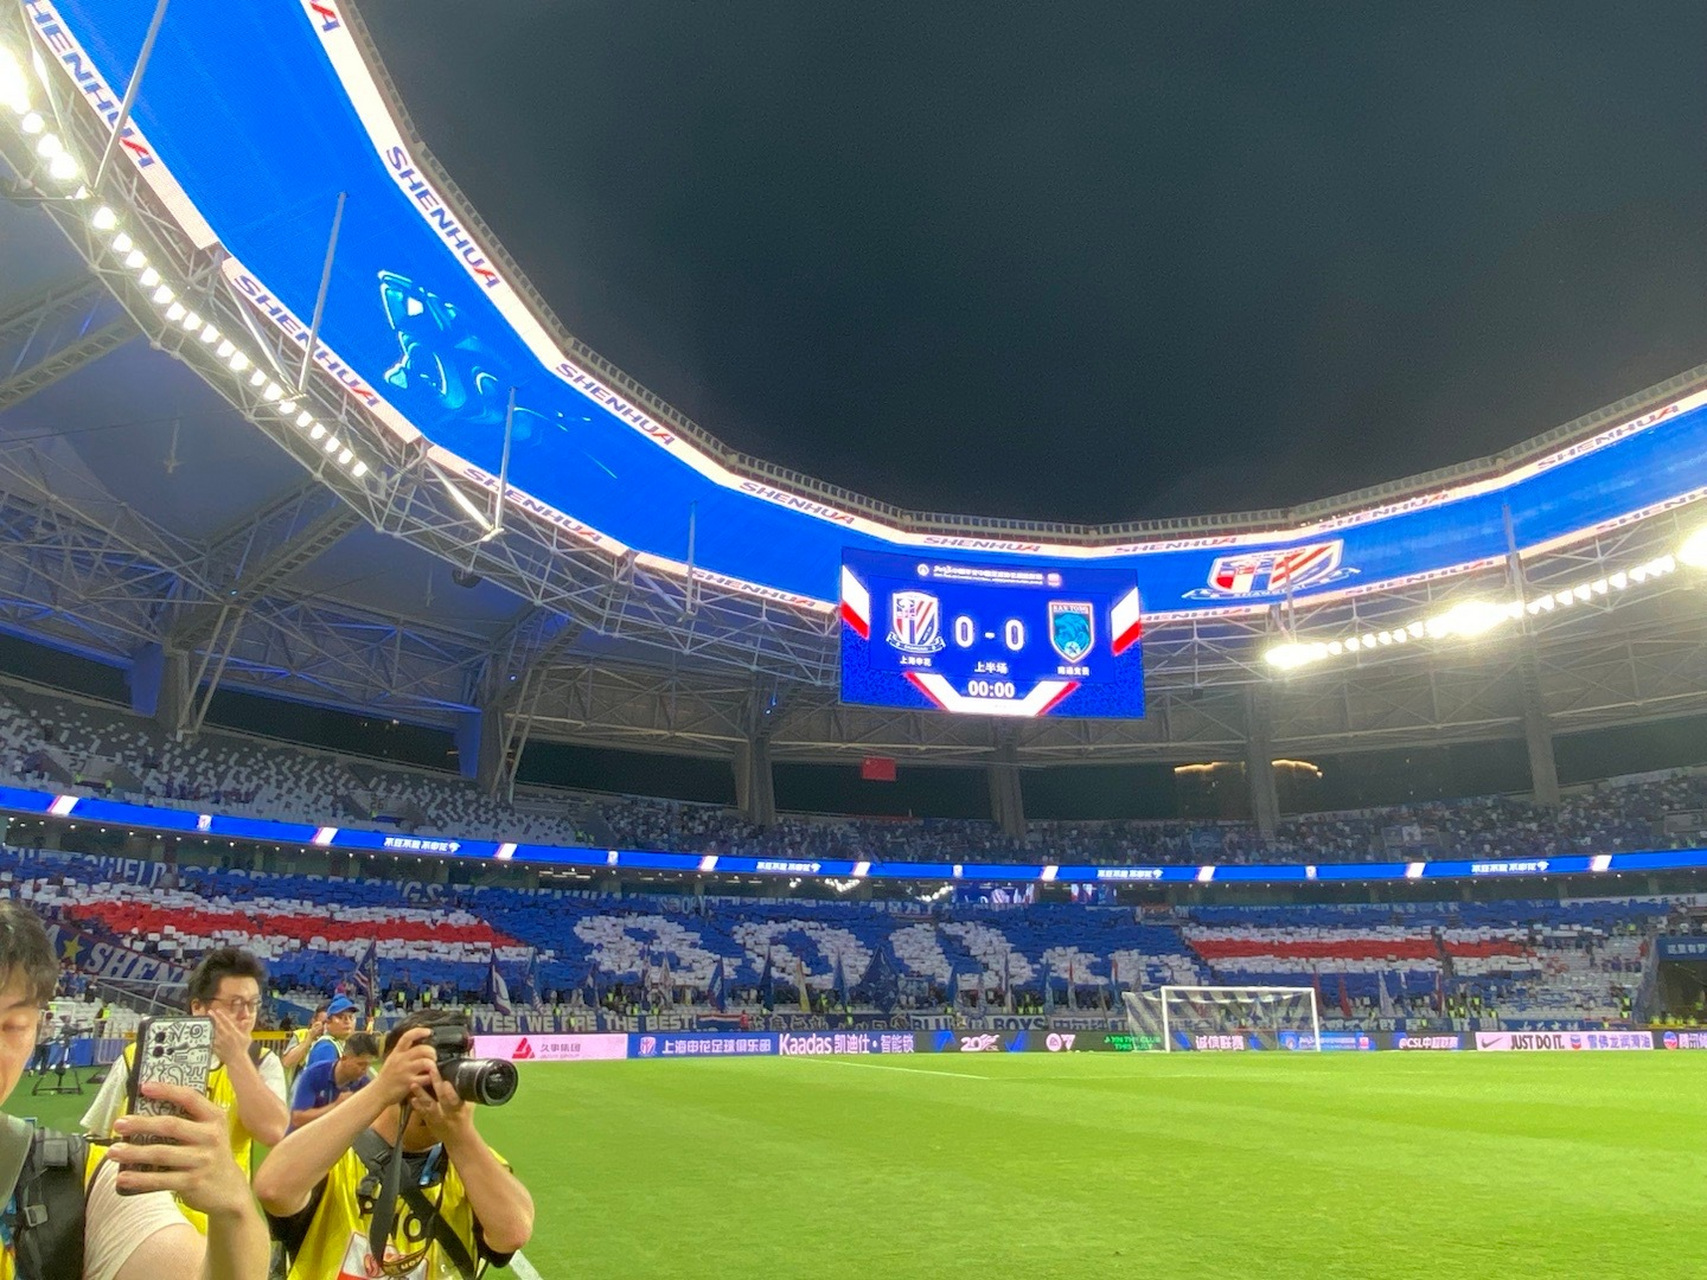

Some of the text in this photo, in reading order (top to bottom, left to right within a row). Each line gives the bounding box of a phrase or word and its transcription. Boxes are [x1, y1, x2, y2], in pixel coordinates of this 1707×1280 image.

[386, 146, 501, 288] SHENHUA
[556, 363, 676, 445] SHENHUA
[1537, 405, 1679, 469] SHENHUA
[739, 482, 855, 524] SHENHUA
[923, 537, 1041, 552] SHENHUA
[955, 615, 974, 648] 0
[1005, 619, 1024, 651] 0
[974, 661, 1009, 675] 上半场
[968, 680, 1016, 699] 00:00
[527, 1015, 555, 1032] WE
[603, 1013, 639, 1032] THE
[646, 1014, 697, 1032] BEST!
[662, 1038, 772, 1055] 上海申花足球俱乐部
[779, 1032, 832, 1056] Kaadas
[1195, 1035, 1245, 1050] 诚信联赛
[1511, 1034, 1534, 1050] JUST
[1535, 1034, 1551, 1049] DO
